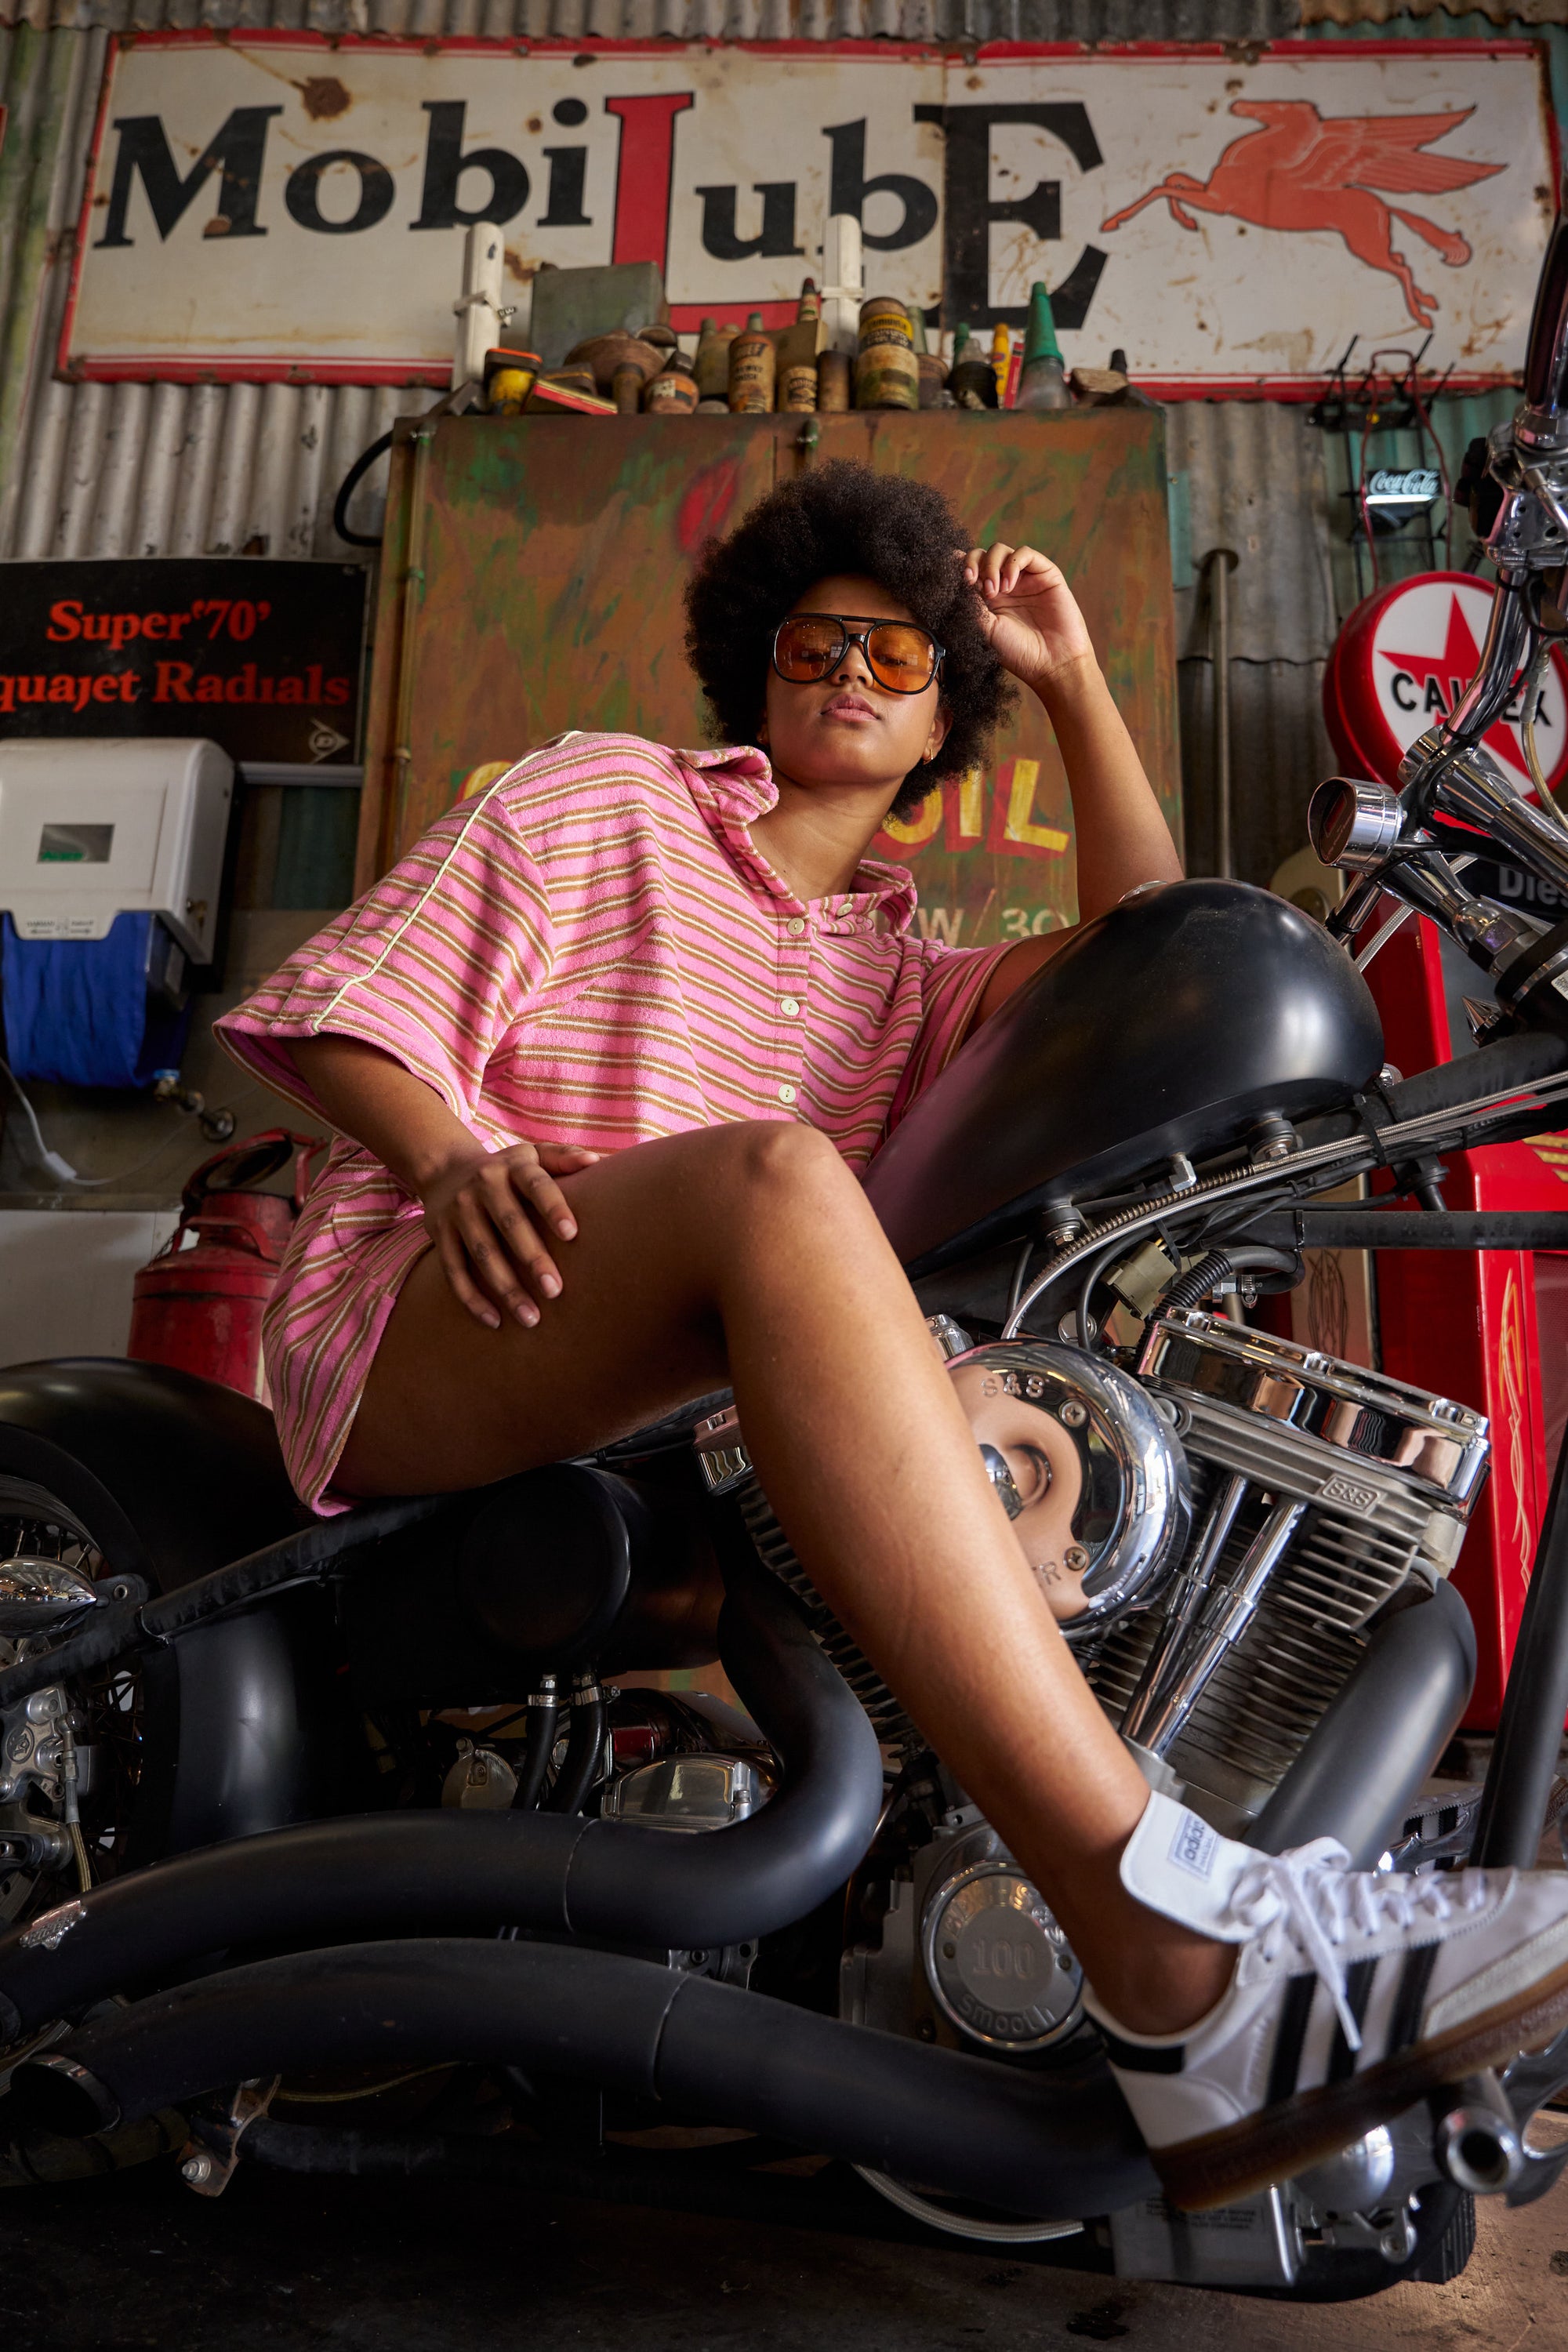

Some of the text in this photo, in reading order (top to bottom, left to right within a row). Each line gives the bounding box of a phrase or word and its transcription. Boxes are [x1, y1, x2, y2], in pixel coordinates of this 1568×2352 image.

[152, 660, 350, 705] Radials
[980, 1373, 1045, 1399] S&S
[1330, 1481, 1371, 1505] S&S
[971, 1939, 1036, 1980] 100
